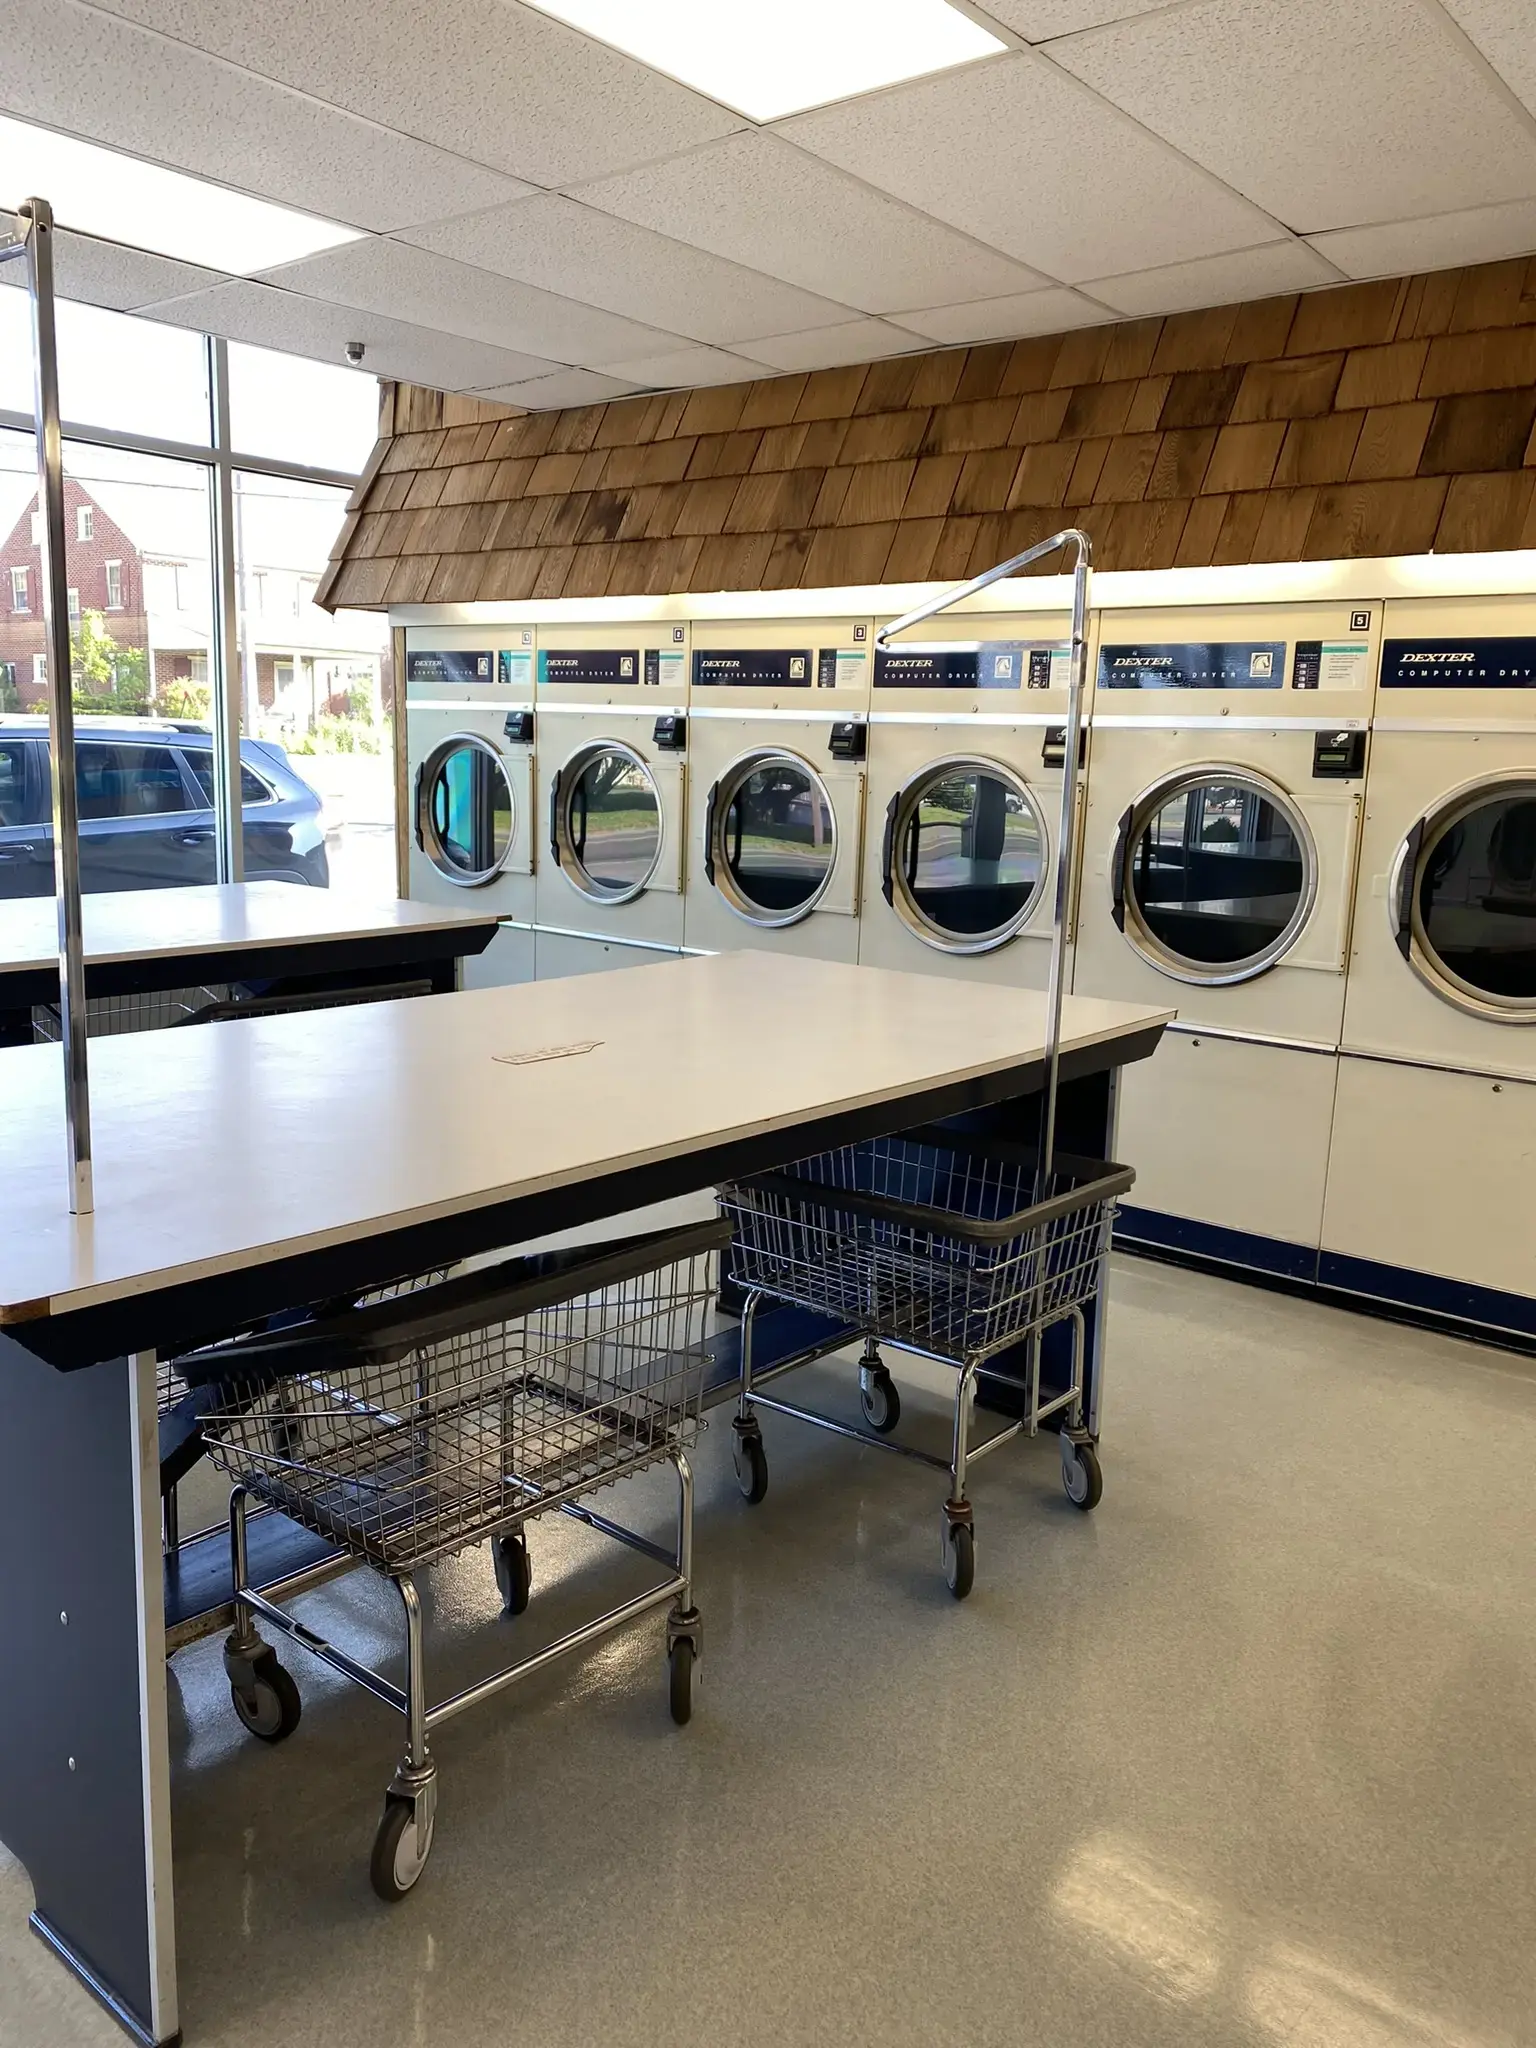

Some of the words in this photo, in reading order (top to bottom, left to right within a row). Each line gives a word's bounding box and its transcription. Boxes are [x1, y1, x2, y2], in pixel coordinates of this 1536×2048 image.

[1356, 616, 1364, 625] 5
[1113, 657, 1173, 666] DEXTER
[1400, 652, 1476, 662] DEXTER
[545, 659, 579, 667] DEXTER
[701, 660, 741, 668] DEXTER
[885, 659, 934, 668] DEXTER
[1397, 669, 1486, 677] COMPUTER
